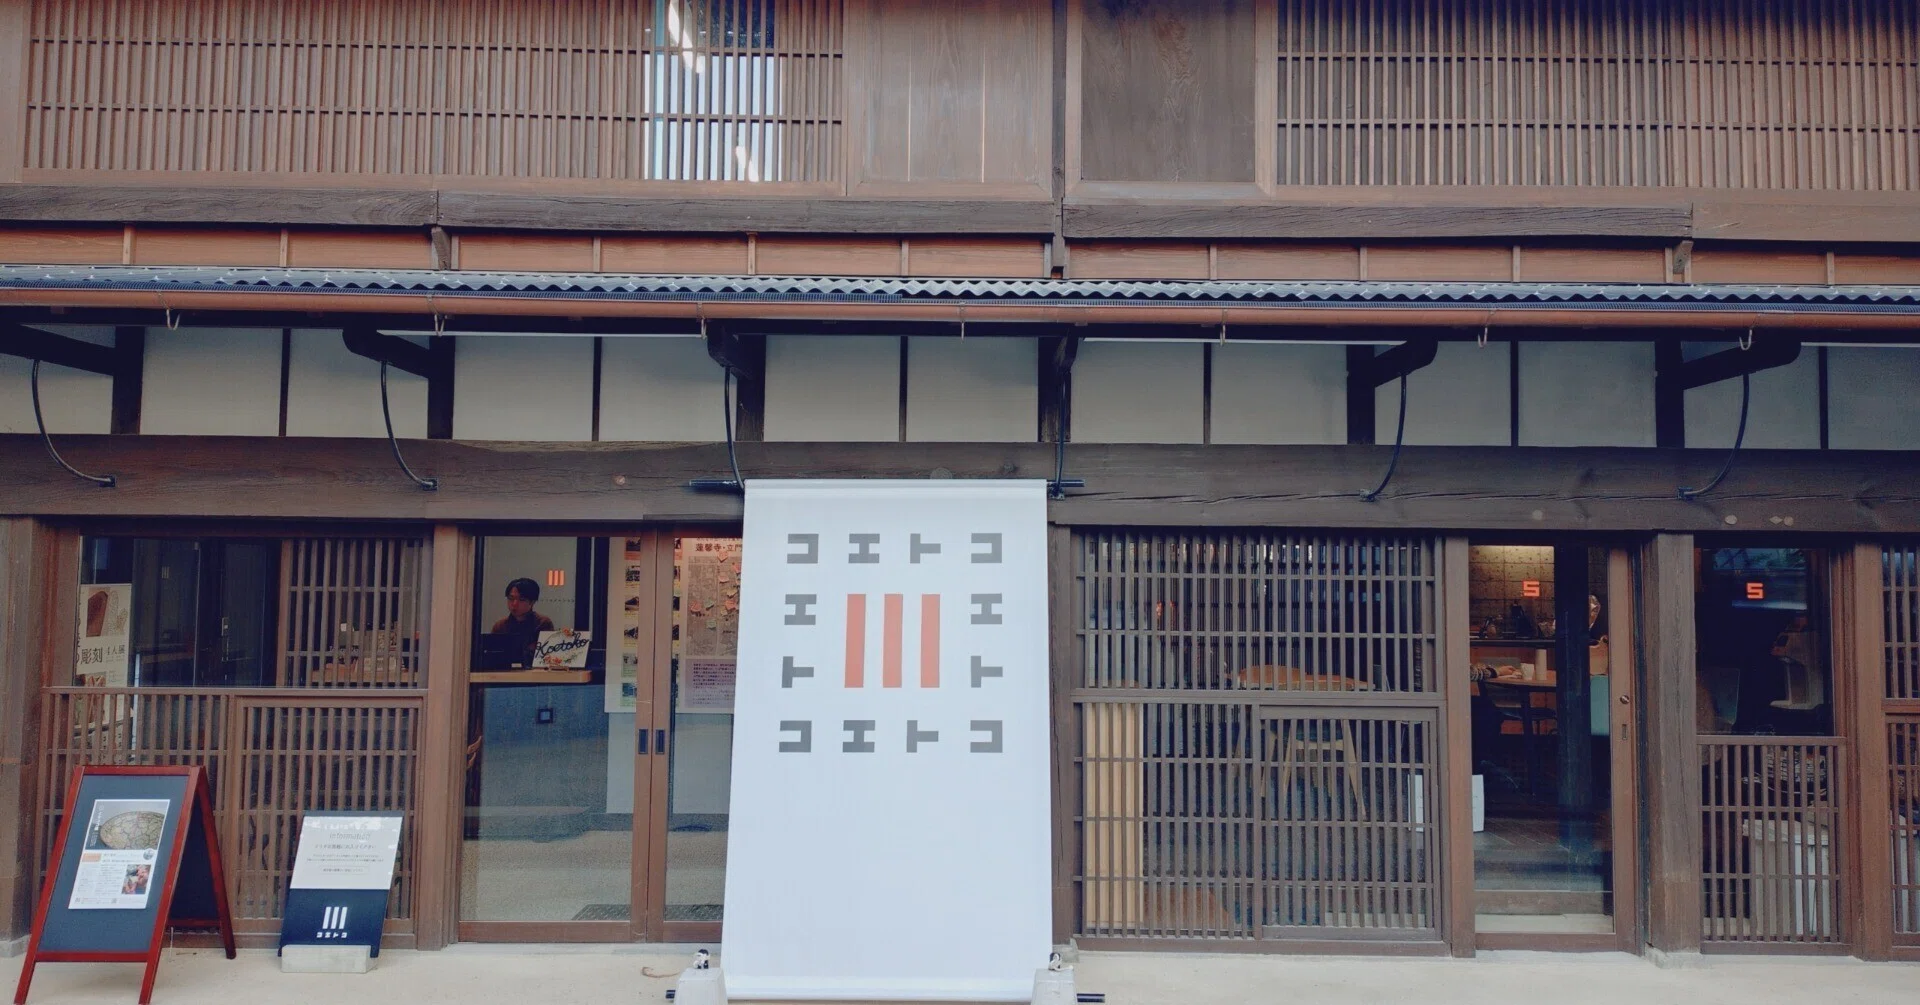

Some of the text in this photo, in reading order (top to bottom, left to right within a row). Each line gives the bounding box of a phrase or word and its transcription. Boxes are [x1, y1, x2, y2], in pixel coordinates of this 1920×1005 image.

[787, 533, 1003, 564] コエトコ
[779, 720, 1003, 753] コエトコ
[316, 931, 348, 939] コエトコ
